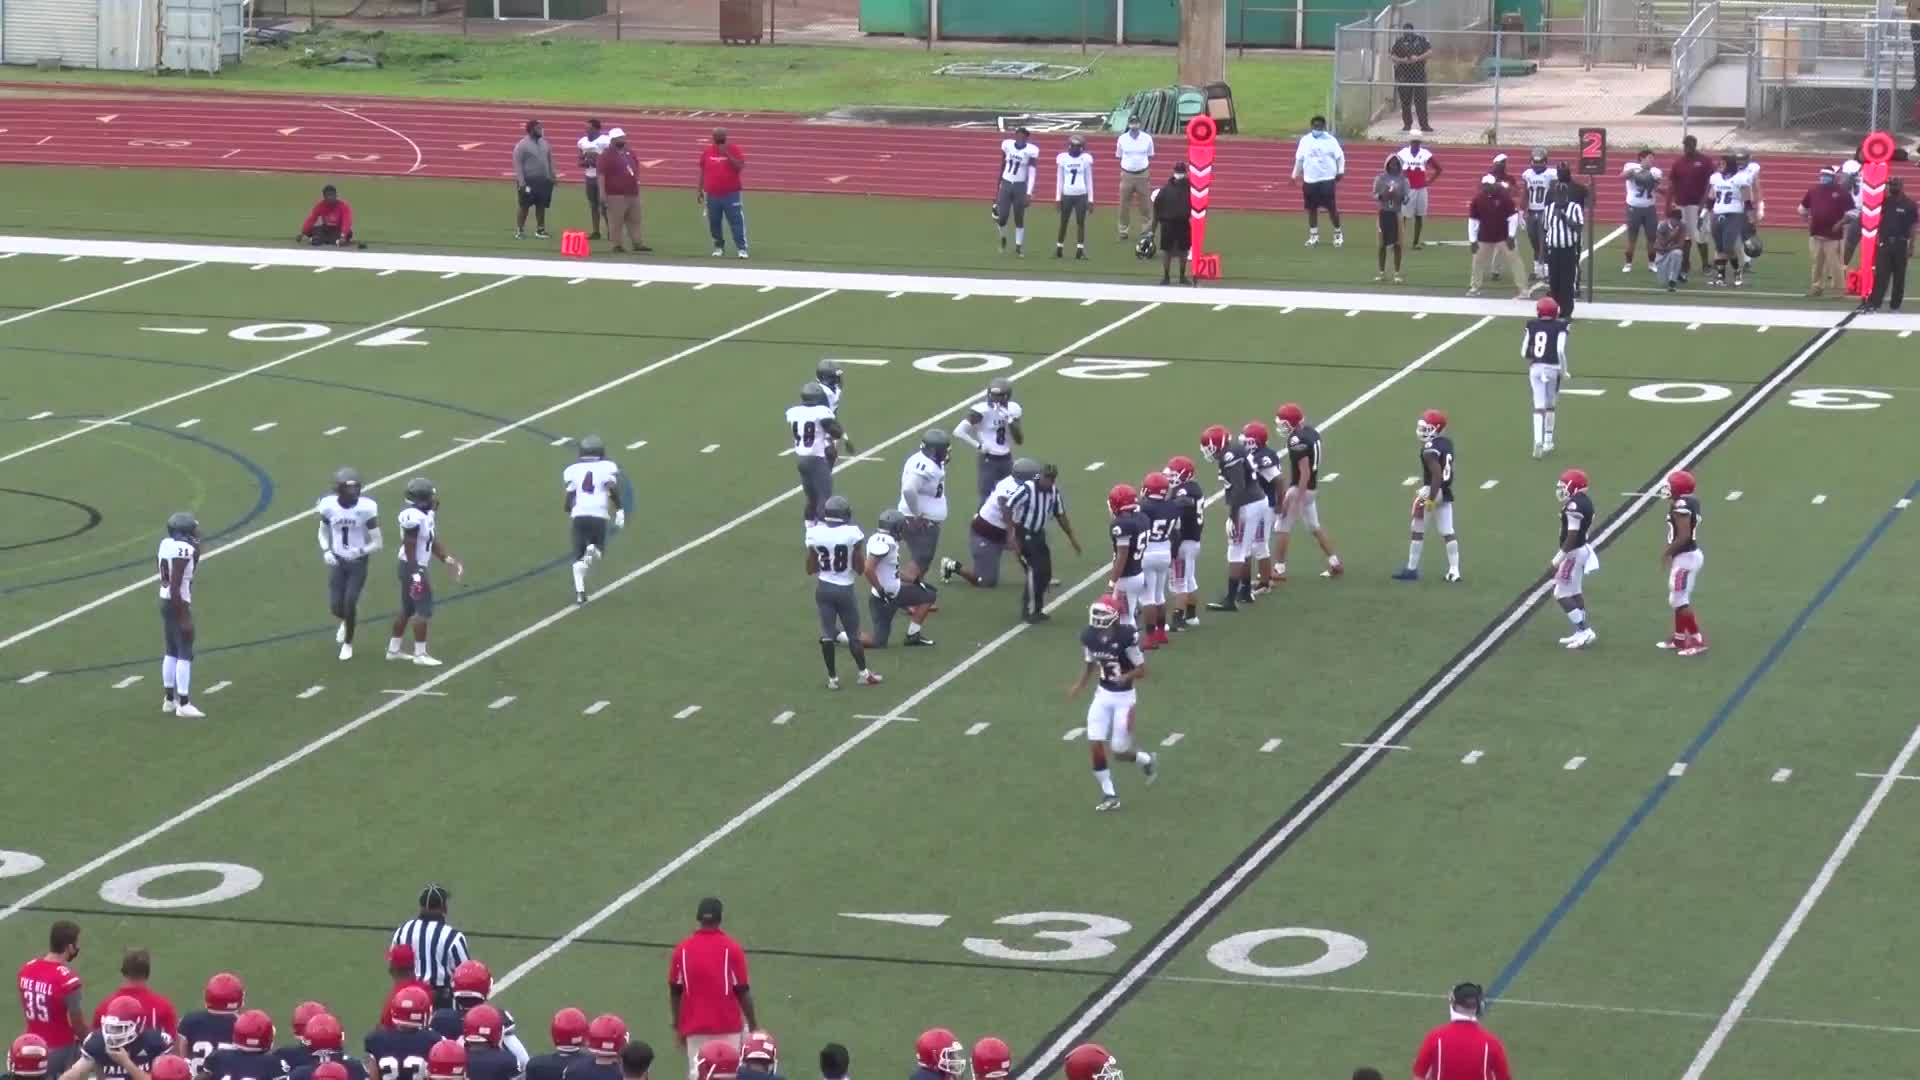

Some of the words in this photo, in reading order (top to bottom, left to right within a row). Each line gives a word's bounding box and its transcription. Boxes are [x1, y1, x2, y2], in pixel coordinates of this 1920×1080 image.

[1583, 132, 1601, 157] 2
[565, 234, 581, 253] 10
[1534, 331, 1547, 358] 8
[581, 471, 595, 495] 4
[20, 977, 34, 991] THE
[34, 981, 53, 996] HILL
[24, 992, 49, 1022] 35
